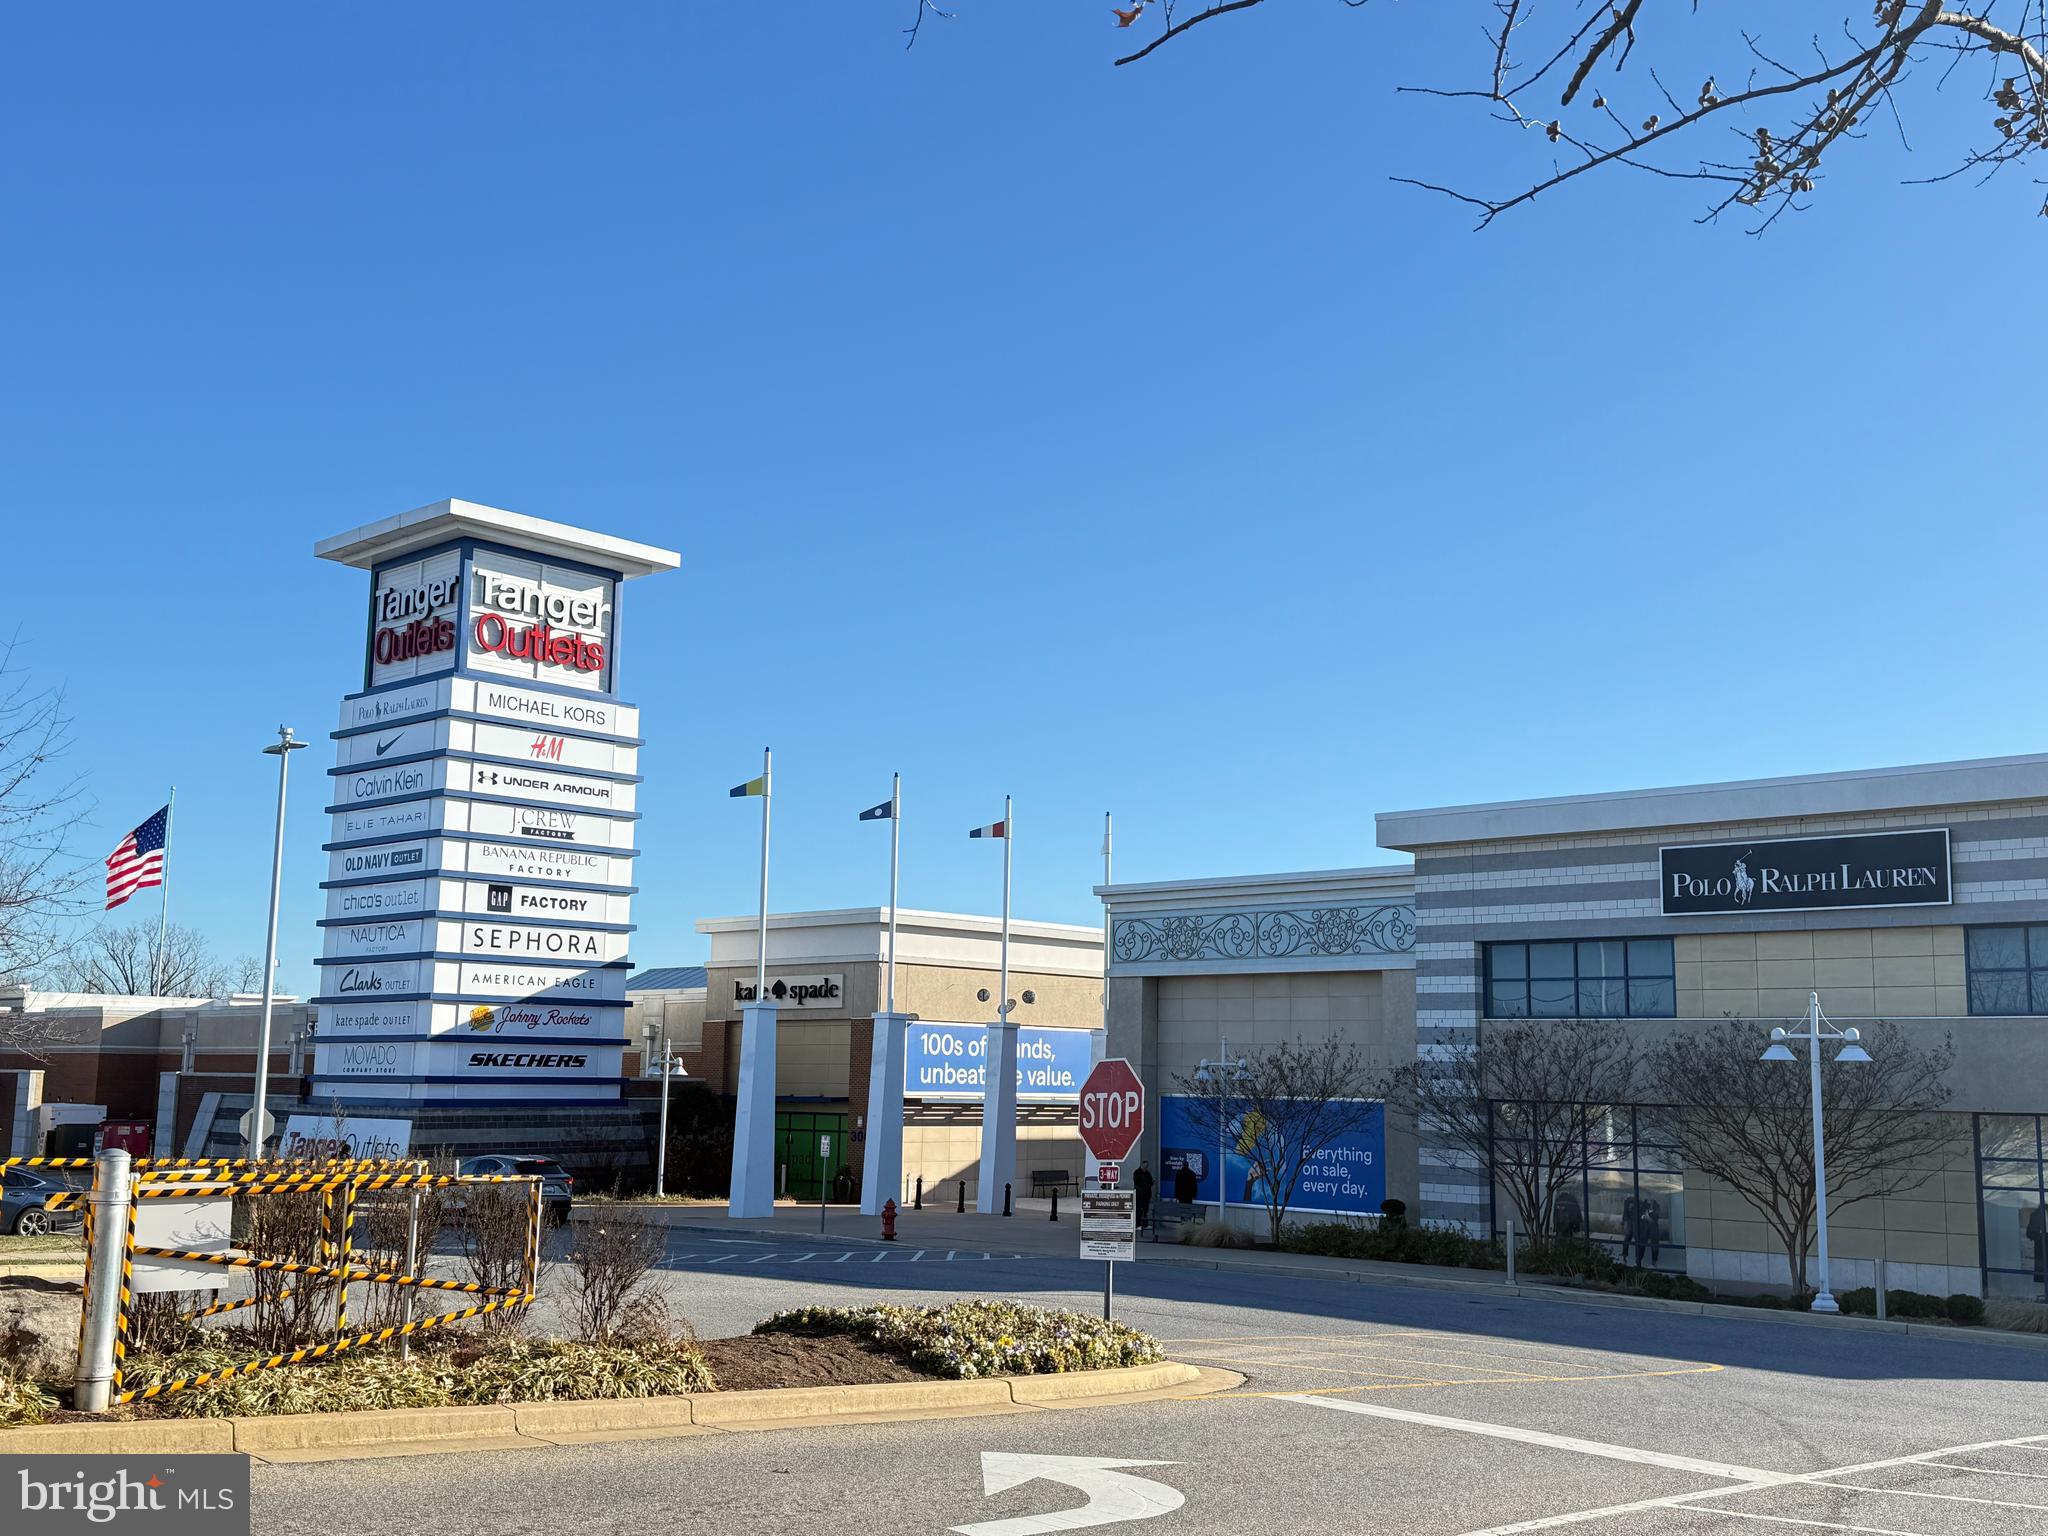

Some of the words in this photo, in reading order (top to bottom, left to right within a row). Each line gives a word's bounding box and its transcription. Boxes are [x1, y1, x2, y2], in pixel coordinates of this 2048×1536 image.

[376, 575, 458, 621] Tanger
[477, 569, 611, 629] Tanger
[375, 616, 456, 664] Outlets
[476, 612, 605, 671] Outlets
[489, 693, 560, 718] MICHAEL
[563, 705, 606, 725] KORS
[530, 734, 565, 761] H&M
[355, 775, 393, 798] Calvin
[394, 769, 424, 792] Klein
[503, 776, 549, 790] UNDER
[553, 783, 610, 798] ARMOUR
[347, 818, 375, 832] ELIE
[379, 811, 426, 826] TAHARI
[509, 807, 577, 834] J.CREW
[530, 828, 567, 838] FACTORY
[345, 856, 363, 872] OLD
[364, 852, 390, 869] NAVY
[394, 851, 420, 863] OUTLET
[482, 845, 536, 861] BANANA
[539, 851, 598, 867] REPUBLIC
[509, 864, 571, 878] FACTORY
[343, 893, 382, 911] chico's
[384, 889, 419, 907] outlet
[491, 890, 509, 907] GAP
[520, 895, 588, 911] FACTORY
[350, 925, 406, 943] NAUTICA
[473, 927, 598, 955] SEPHORA
[340, 968, 382, 992] Clarks
[385, 979, 411, 991] OUTLET
[471, 973, 547, 987] AMERICAN
[555, 977, 596, 989] EAGLE
[789, 977, 839, 1006] spade
[335, 1013, 353, 1027] kate
[354, 1012, 380, 1029] spade
[382, 1015, 411, 1025] OUTLET
[495, 1006, 543, 1033] Johnny
[542, 1009, 590, 1026] Rockets
[343, 1045, 397, 1065] MOVADO
[920, 1032, 963, 1057] 100s
[968, 1035, 987, 1057] of
[468, 1053, 588, 1067] SKECHERS
[1028, 1065, 1076, 1087] value.
[1082, 1091, 1139, 1129] STOP
[345, 1133, 400, 1160] Outlets
[1302, 1145, 1372, 1166] Everything
[1099, 1169, 1118, 1180] 3-WAY
[1302, 1164, 1319, 1176] on
[1322, 1163, 1352, 1179] sale,
[1302, 1181, 1338, 1197] every
[1341, 1180, 1368, 1198] day.
